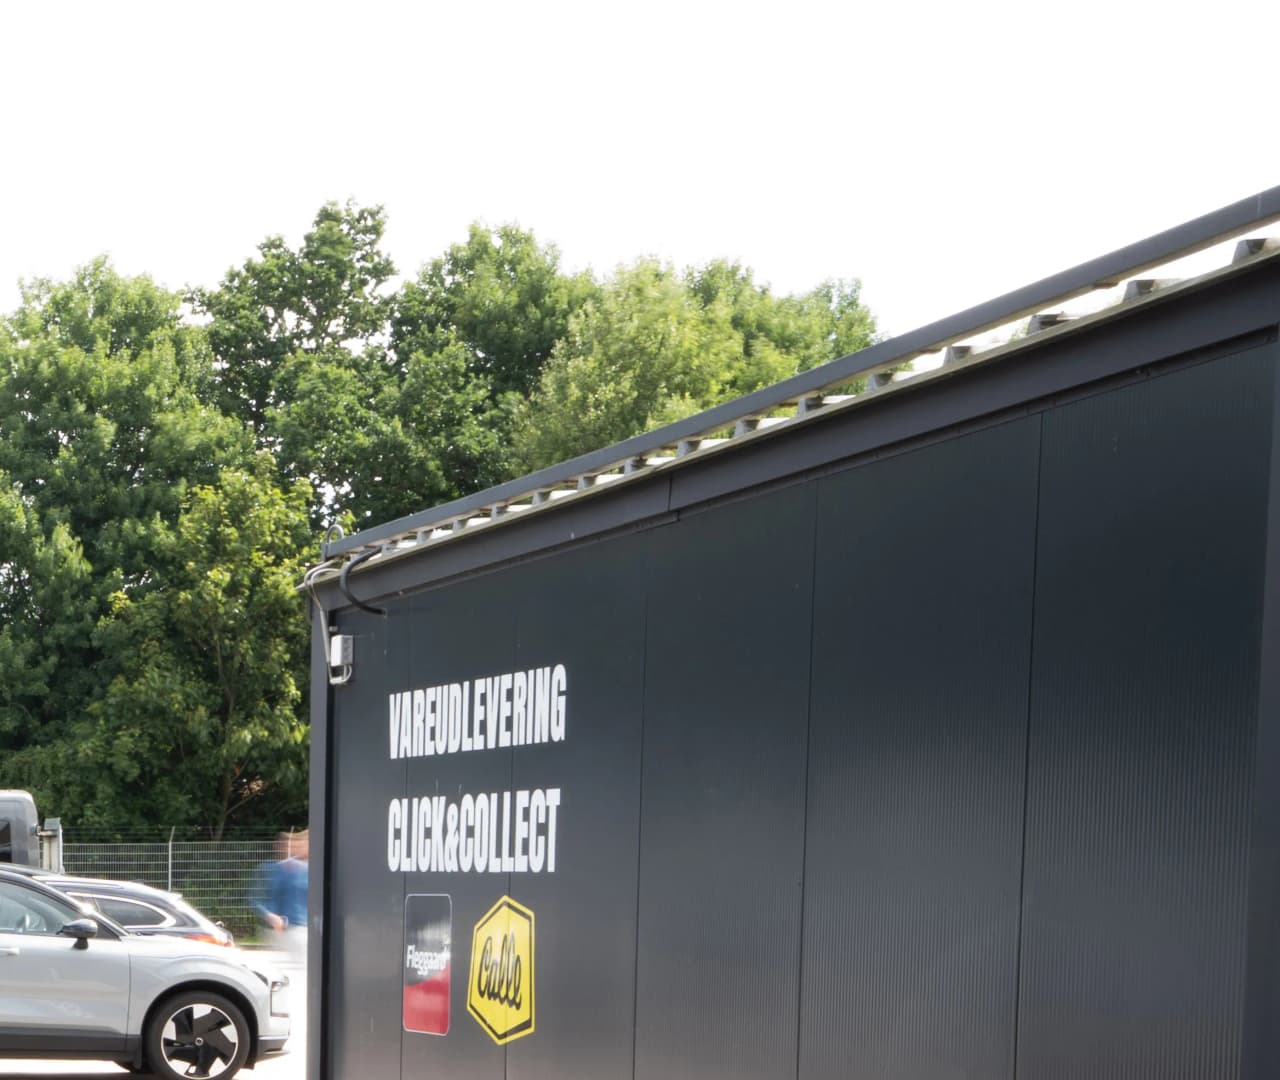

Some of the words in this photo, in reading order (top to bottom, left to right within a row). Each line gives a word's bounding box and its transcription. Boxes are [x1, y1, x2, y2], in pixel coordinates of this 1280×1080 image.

[388, 664, 567, 760] VAREUDLEVERING
[387, 788, 561, 873] CLICK&COLLECT
[477, 932, 522, 1011] Calle
